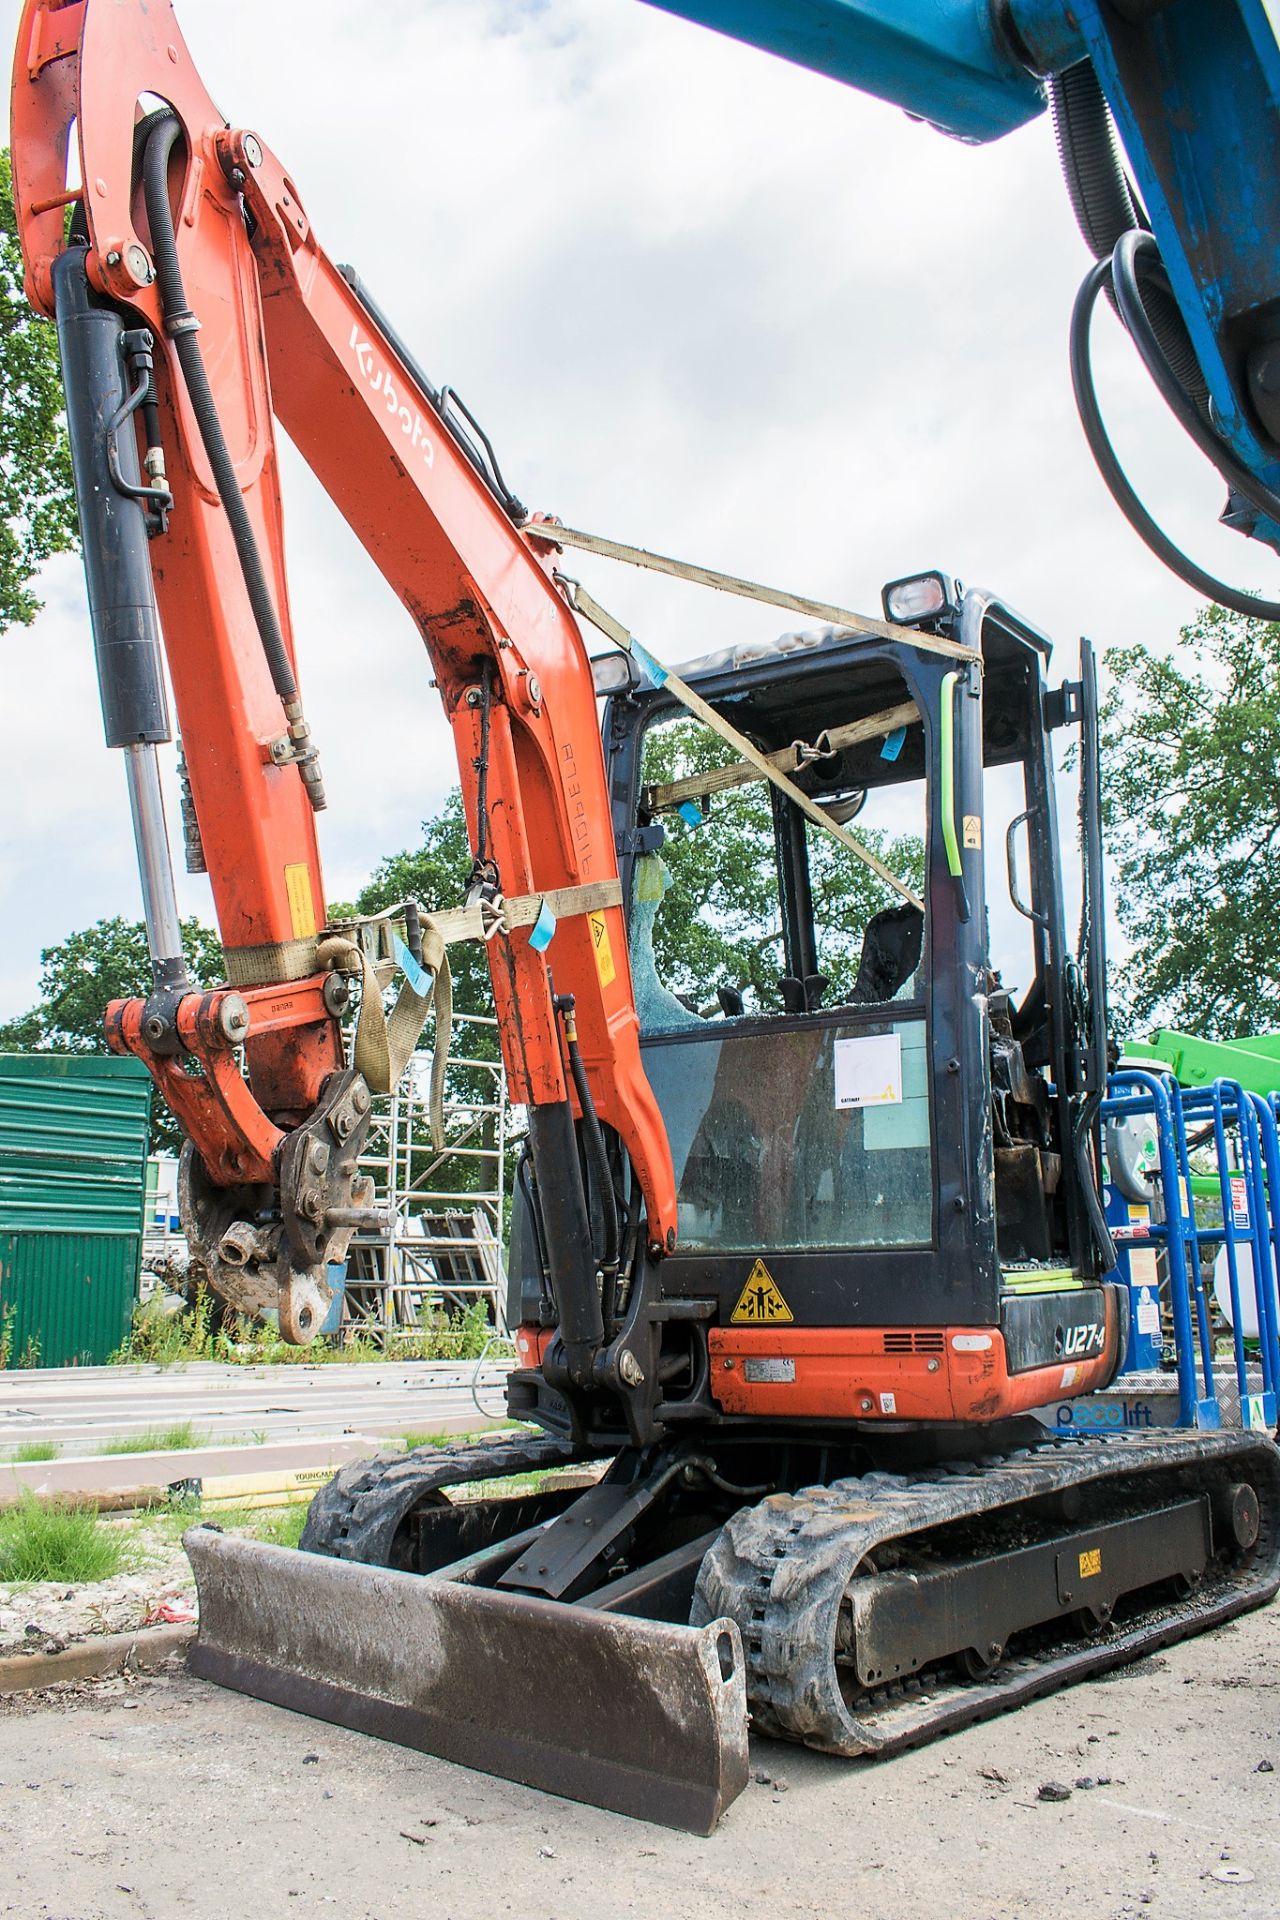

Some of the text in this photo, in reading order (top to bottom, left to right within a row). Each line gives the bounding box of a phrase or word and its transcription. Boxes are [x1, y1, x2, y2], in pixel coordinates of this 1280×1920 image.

[349, 323, 435, 470] Kubota
[1064, 1323, 1105, 1355] U27-4
[1056, 1401, 1153, 1427] pecolift
